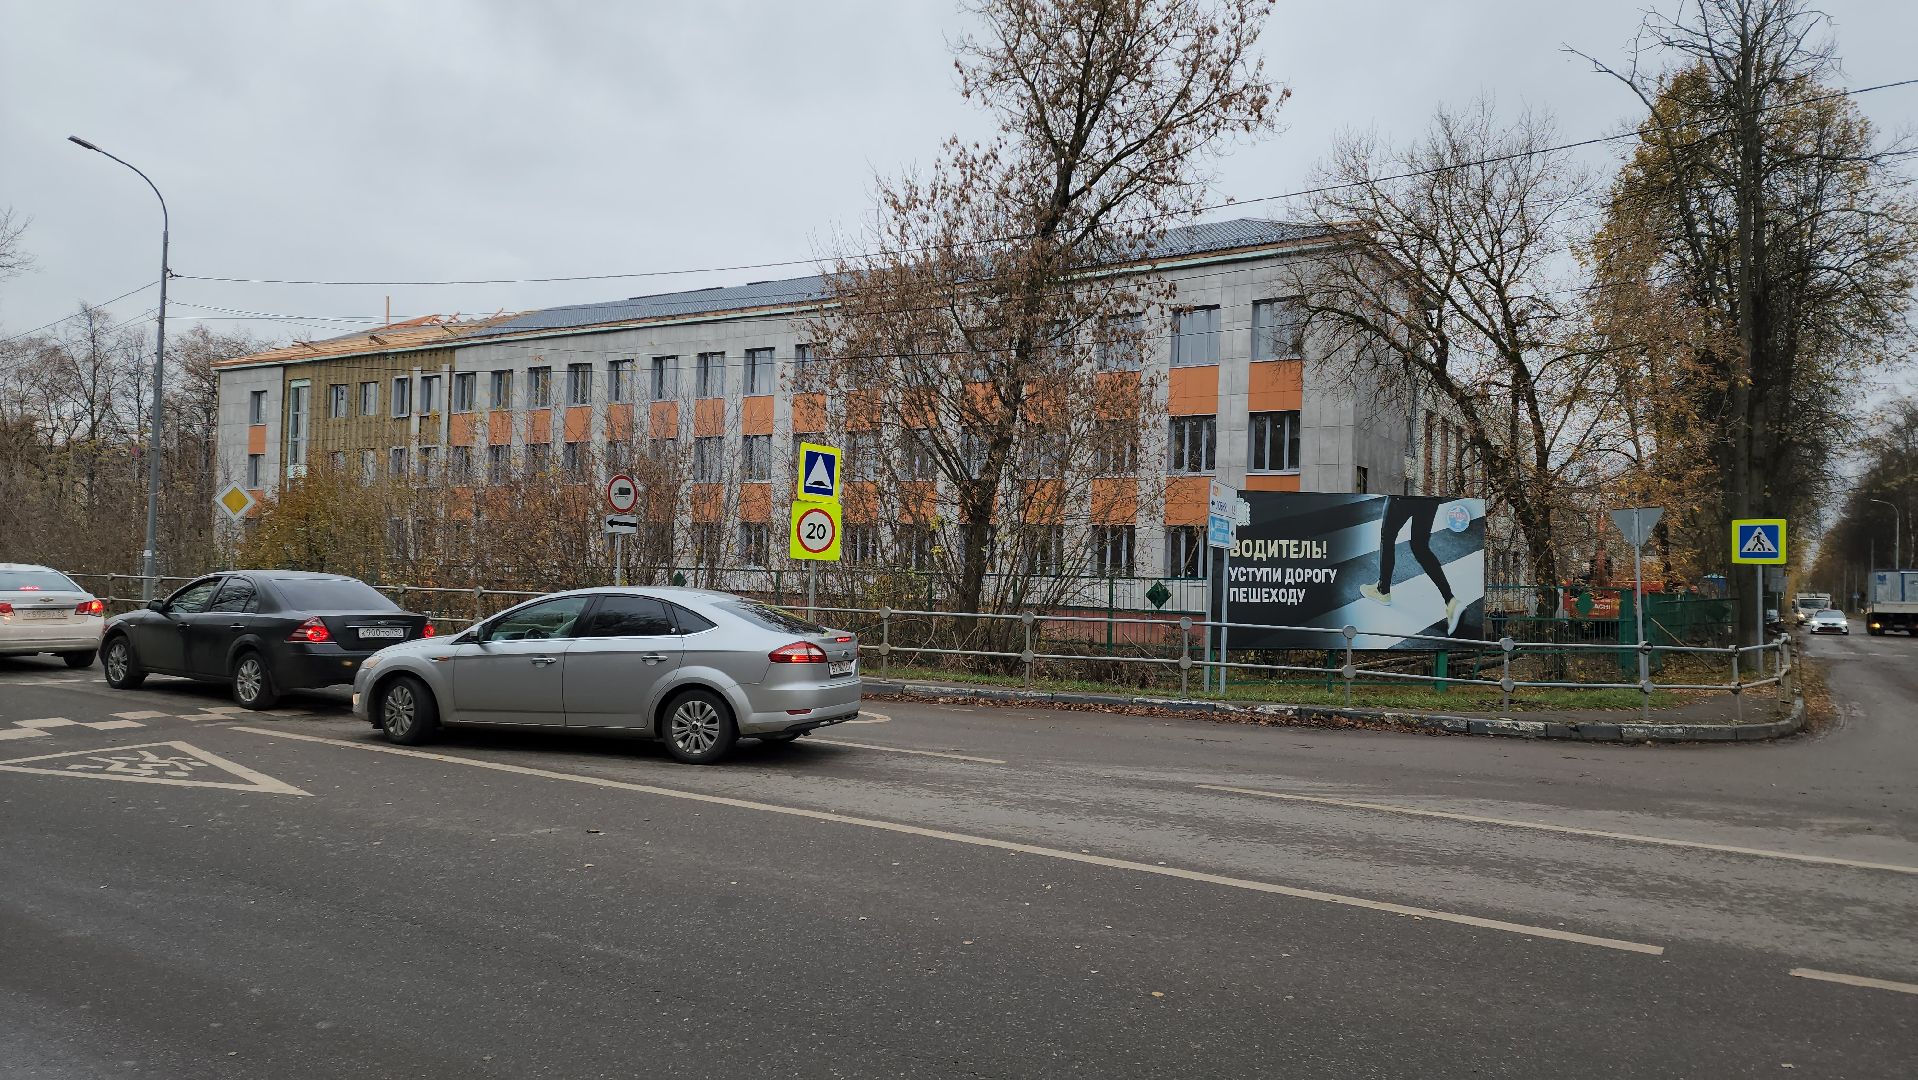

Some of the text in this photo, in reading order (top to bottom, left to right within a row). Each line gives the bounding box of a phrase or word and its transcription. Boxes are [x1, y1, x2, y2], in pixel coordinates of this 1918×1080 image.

[806, 523, 826, 540] 20
[1229, 540, 1327, 561] ВОДИТЕЛЬ!
[1229, 567, 1338, 585] УСТУПИ ДОРОГУ
[1229, 588, 1306, 606] ПЕШЕХОДУ
